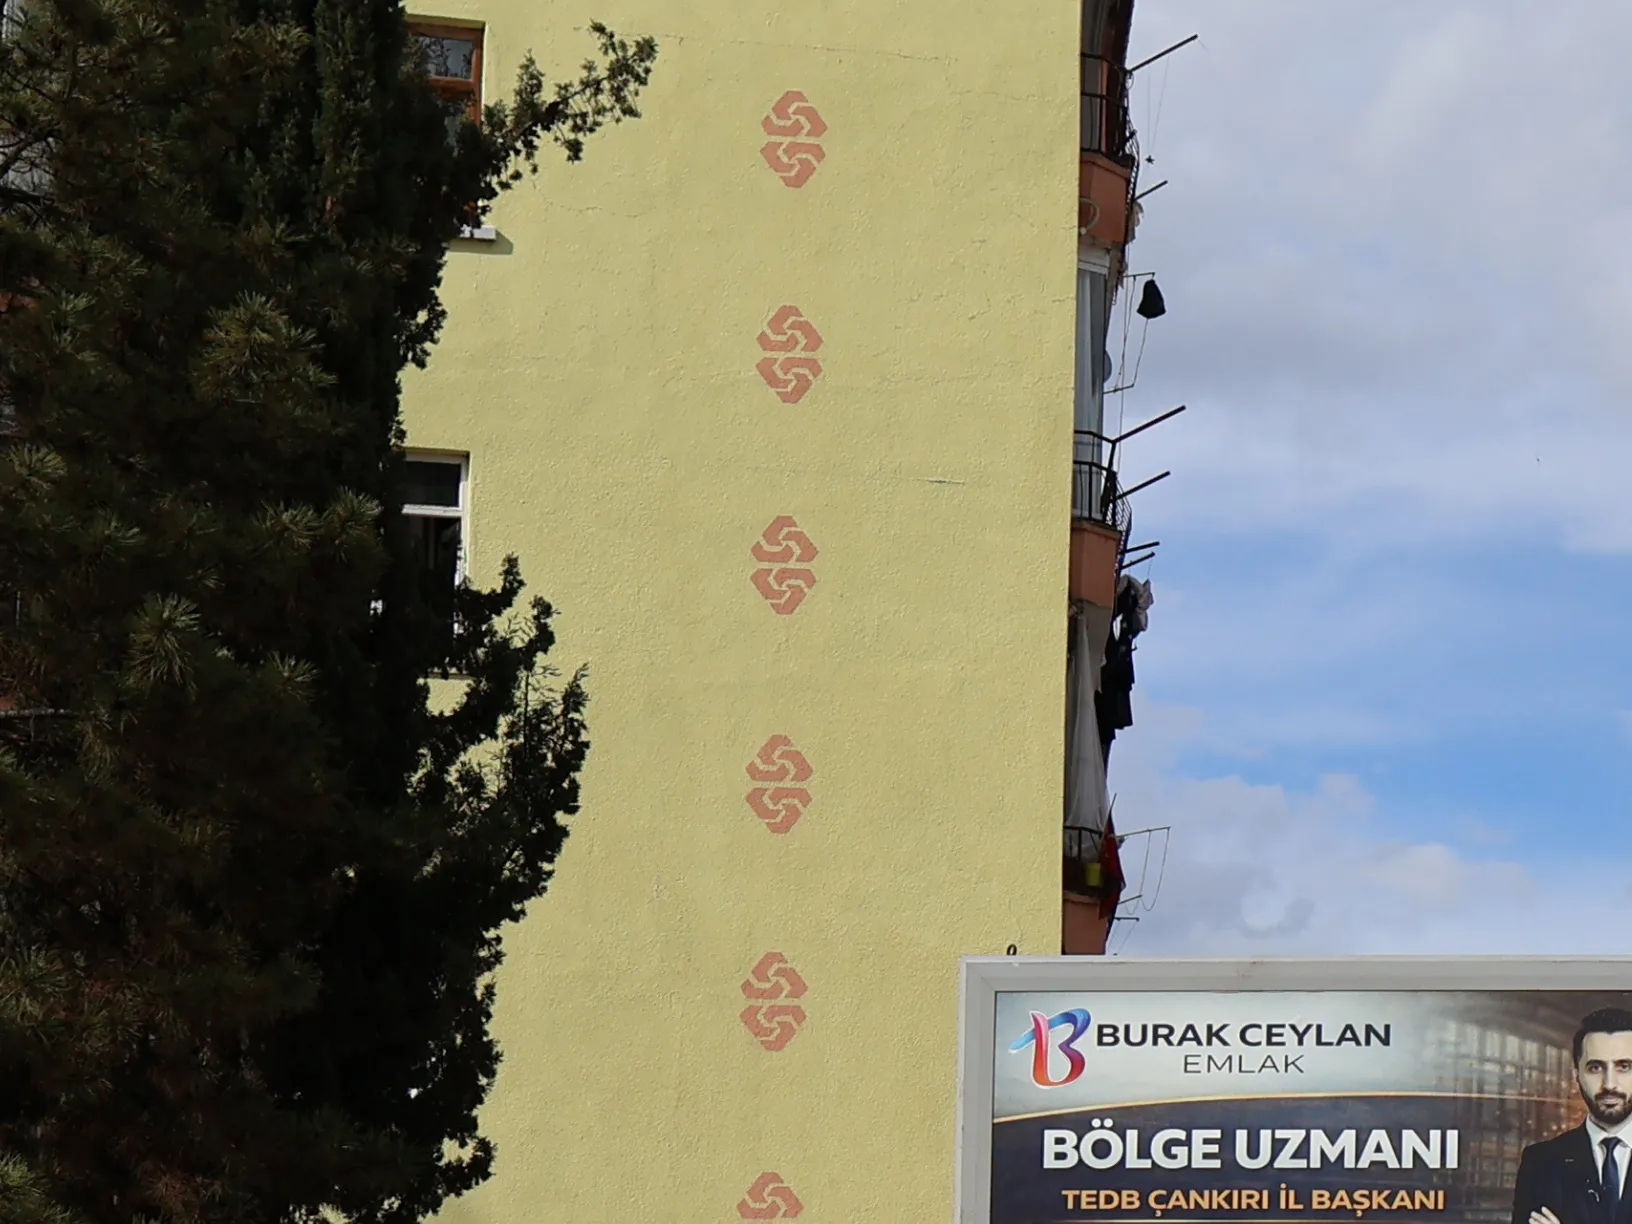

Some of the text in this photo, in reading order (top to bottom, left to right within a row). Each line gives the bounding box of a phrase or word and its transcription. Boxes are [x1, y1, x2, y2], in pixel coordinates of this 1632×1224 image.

[1097, 1023, 1392, 1048] BURAK CEYLAN
[1183, 1054, 1305, 1075] EMLAK
[1042, 1118, 1459, 1171] BÖLGE UZMANI
[1062, 1182, 1445, 1217] TEDB ÇANKIRI İL BAŞKANI
